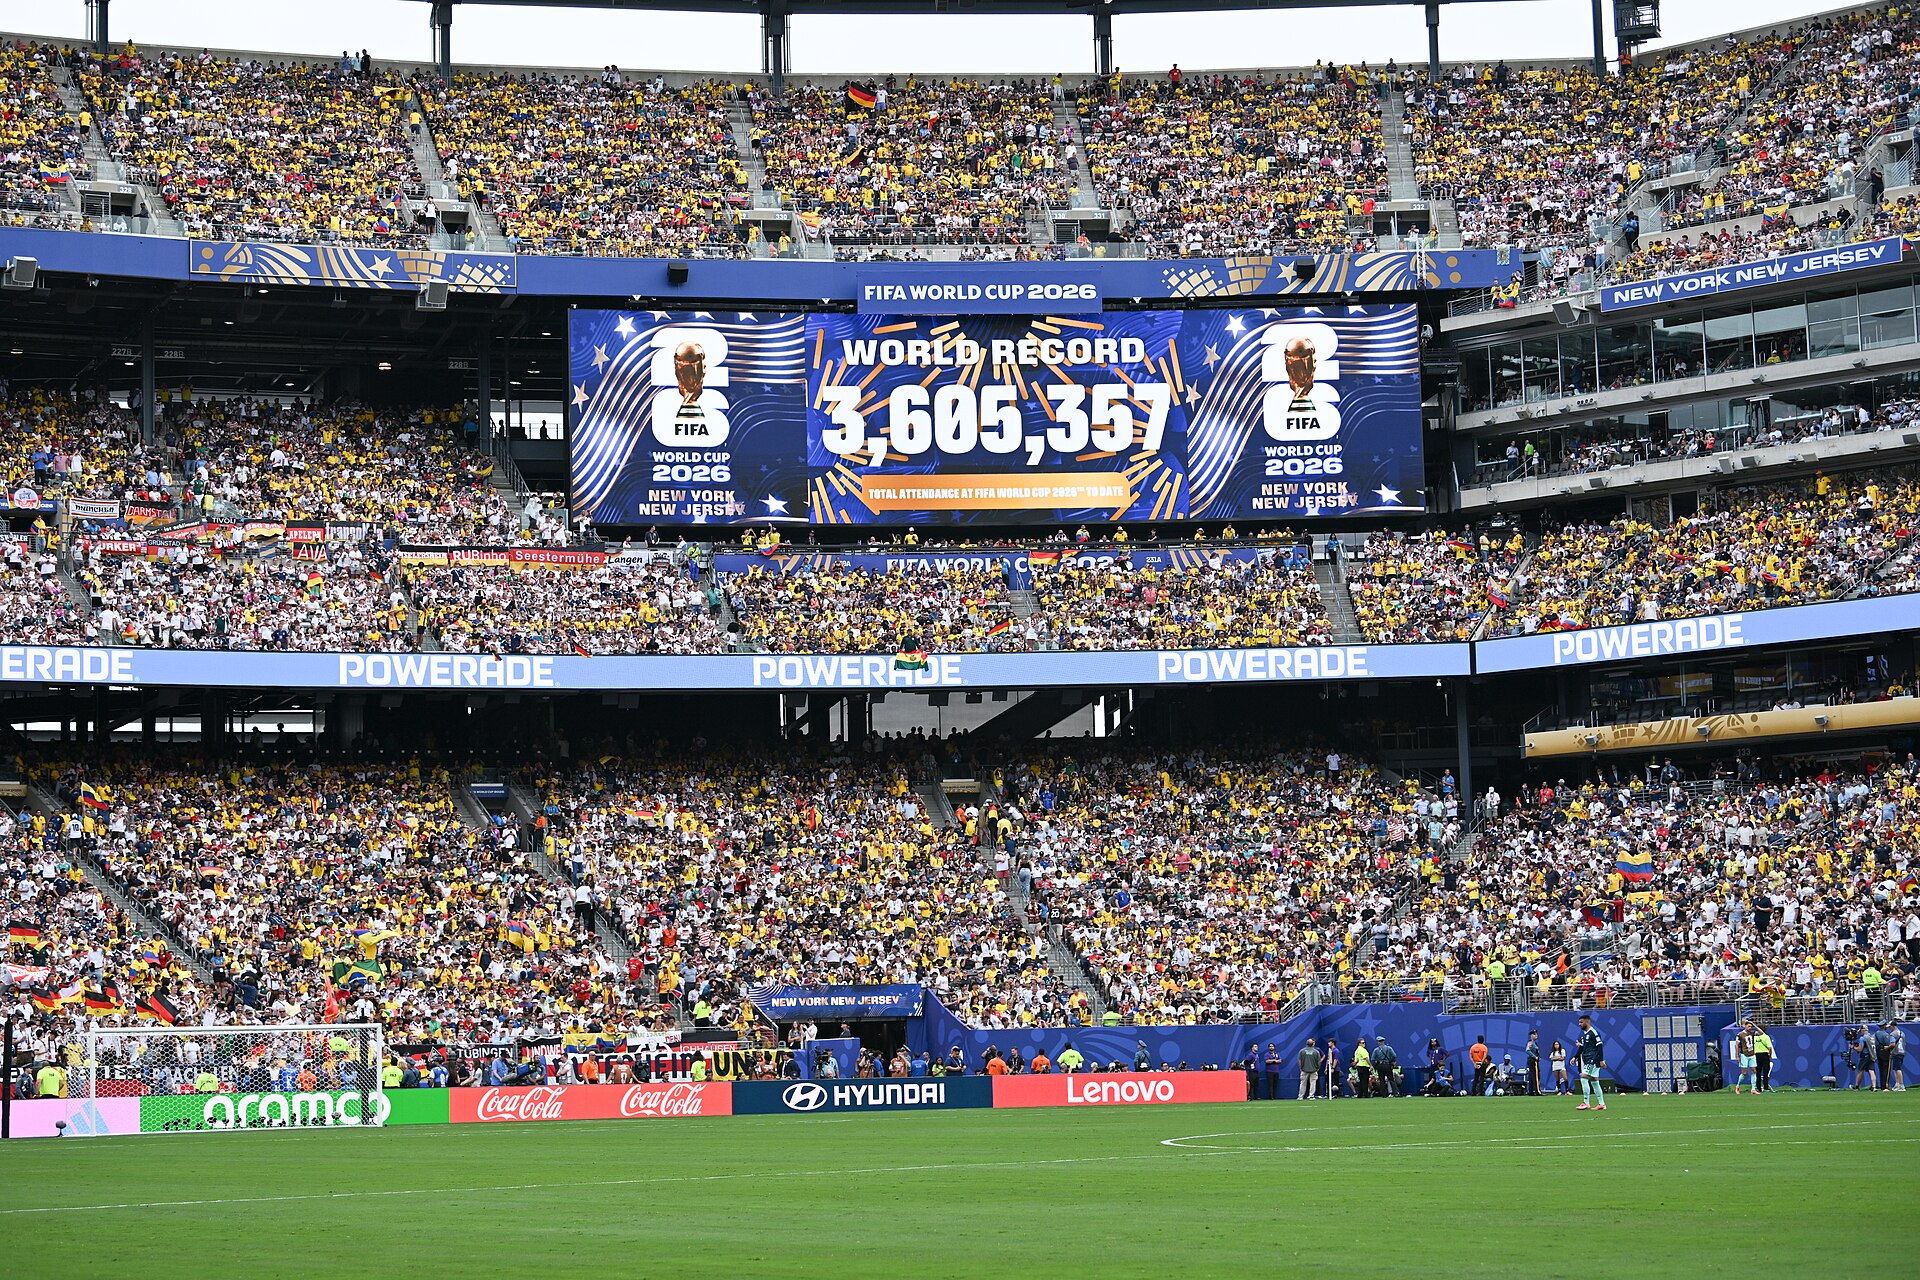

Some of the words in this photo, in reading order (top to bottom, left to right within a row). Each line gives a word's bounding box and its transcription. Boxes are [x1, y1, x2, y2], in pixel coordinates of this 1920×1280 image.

[1614, 284, 1664, 304] NEW
[1668, 272, 1730, 294] YORK
[1735, 262, 1788, 283] NEW
[1792, 245, 1886, 276] JERSEY
[864, 285, 907, 301] FIFA
[909, 284, 982, 300] WORLD
[985, 284, 1025, 300] CUP
[1027, 283, 1097, 300] 2026
[843, 338, 981, 367] WORLD
[991, 337, 1146, 366] RECORD
[674, 424, 710, 436] FIFA
[821, 382, 1172, 467] 3,605,357
[1286, 417, 1321, 430] FIFA
[652, 451, 702, 463] WORLD
[703, 452, 731, 463] CUP
[1264, 445, 1314, 457] WORLD
[1314, 444, 1343, 456] CUP
[652, 465, 731, 482] 2026
[1264, 457, 1343, 476] 2026
[648, 490, 686, 502] NEW
[691, 490, 736, 502] YORK
[868, 488, 898, 500] TOTAL
[898, 488, 960, 499] ATTENDANCE
[960, 488, 974, 499] AT
[974, 487, 996, 498] FIFA
[996, 487, 1030, 498] WORLD
[1031, 487, 1051, 498] CUP
[1085, 486, 1099, 497] TO
[1099, 485, 1124, 497] DATE
[1261, 483, 1299, 496] NEW
[1303, 481, 1349, 494] YORK
[638, 503, 677, 516] NEW
[681, 502, 746, 516] JERSEY
[1252, 497, 1289, 510] NEW
[1294, 495, 1358, 509] JERSEY
[212, 517, 237, 525] TIVOLI
[452, 549, 507, 561] RUBinho
[515, 550, 600, 564] Seestermühe
[607, 555, 643, 566] Langen
[887, 558, 930, 574] FIFA
[1553, 613, 1744, 665] POWERADE
[0, 647, 134, 682] ERADE
[339, 654, 554, 687] POWERADE
[753, 655, 962, 687] POWERADE
[1158, 647, 1368, 681] POWERADE
[771, 997, 797, 1007] NEW
[799, 996, 829, 1007] YORK
[830, 996, 857, 1006] NEW
[857, 995, 900, 1005] JERSEY
[833, 1082, 946, 1106] HYUNDAI
[1067, 1076, 1176, 1104] Lenovo
[477, 1086, 567, 1121] Coca-Cola
[620, 1083, 707, 1117] Coca-Cola
[203, 1091, 391, 1128] aramco
